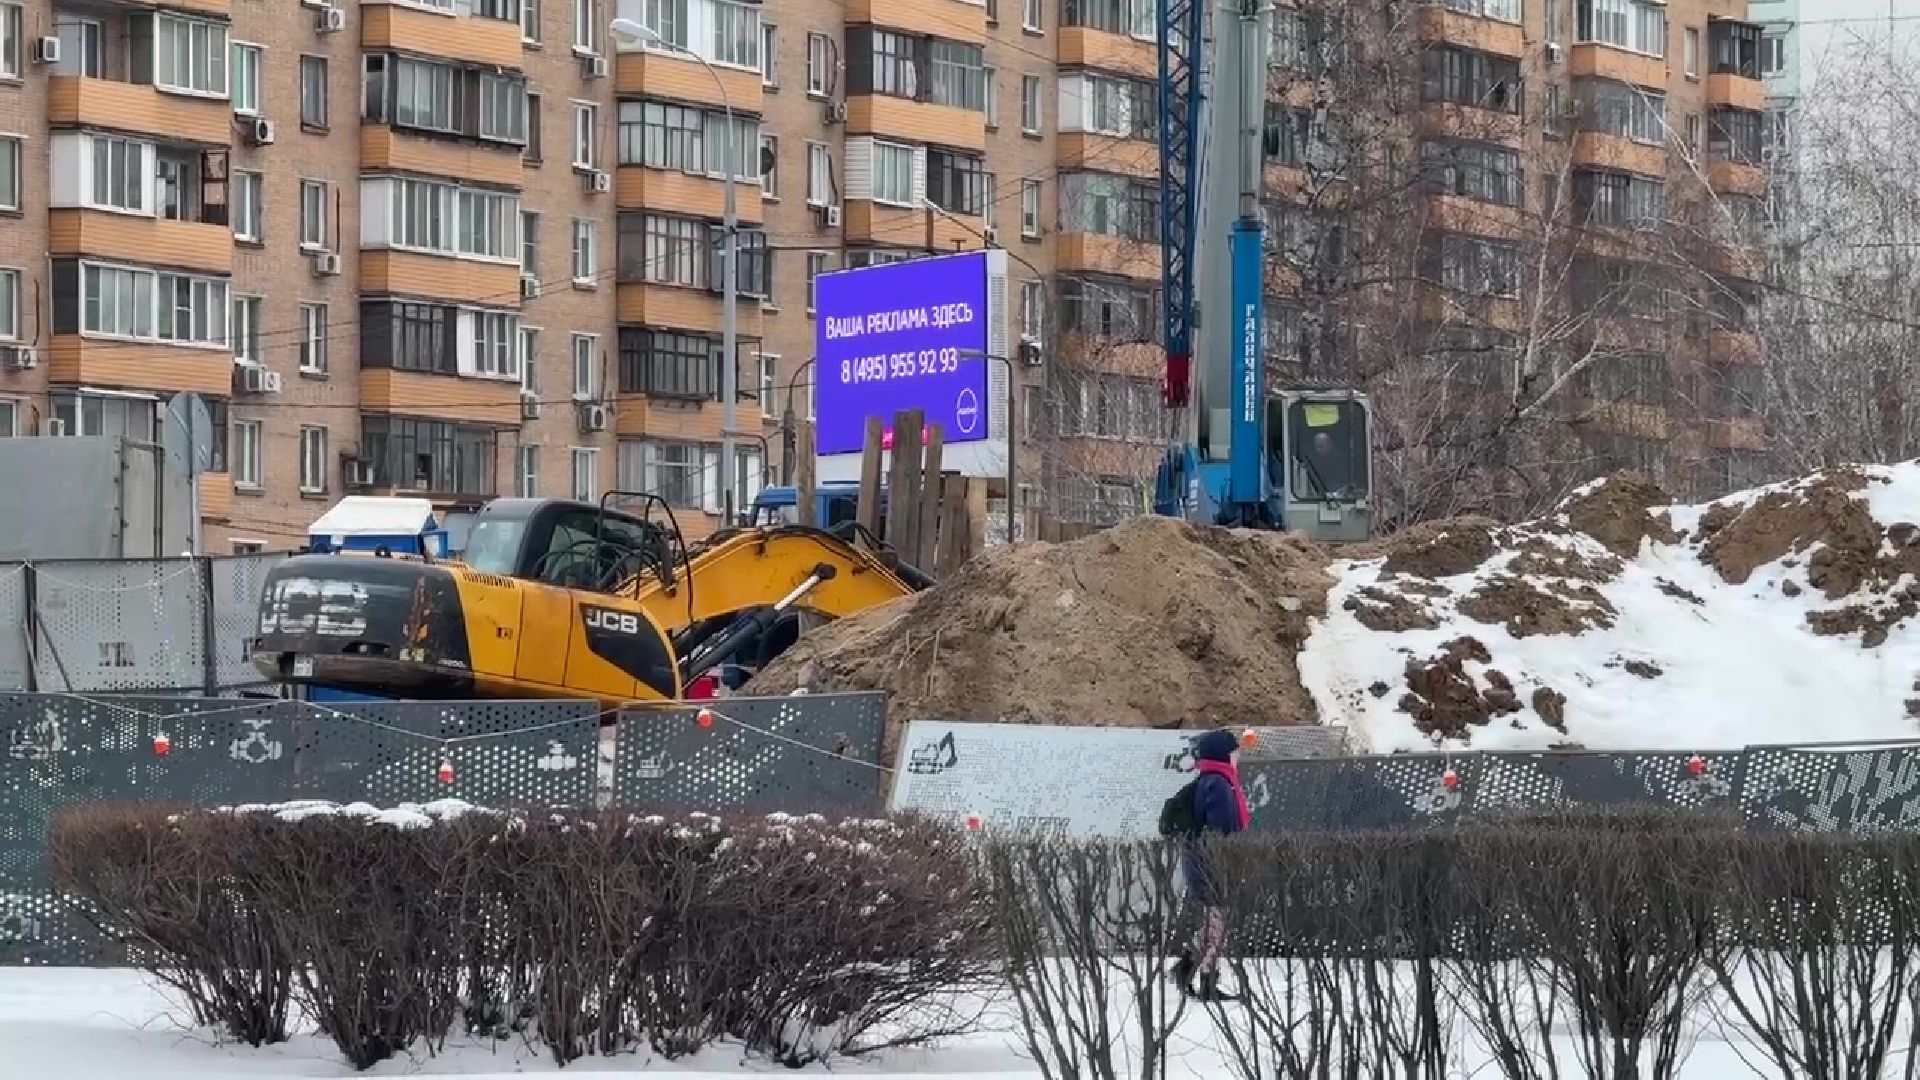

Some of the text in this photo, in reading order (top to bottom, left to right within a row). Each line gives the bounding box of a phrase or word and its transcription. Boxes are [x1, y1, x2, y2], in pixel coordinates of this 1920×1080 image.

[826, 302, 974, 340] ВАША РЕКЛАМА ЗДЕСЬ
[841, 347, 958, 385] 8 (495) 955 92 93
[586, 607, 638, 634] JCB
